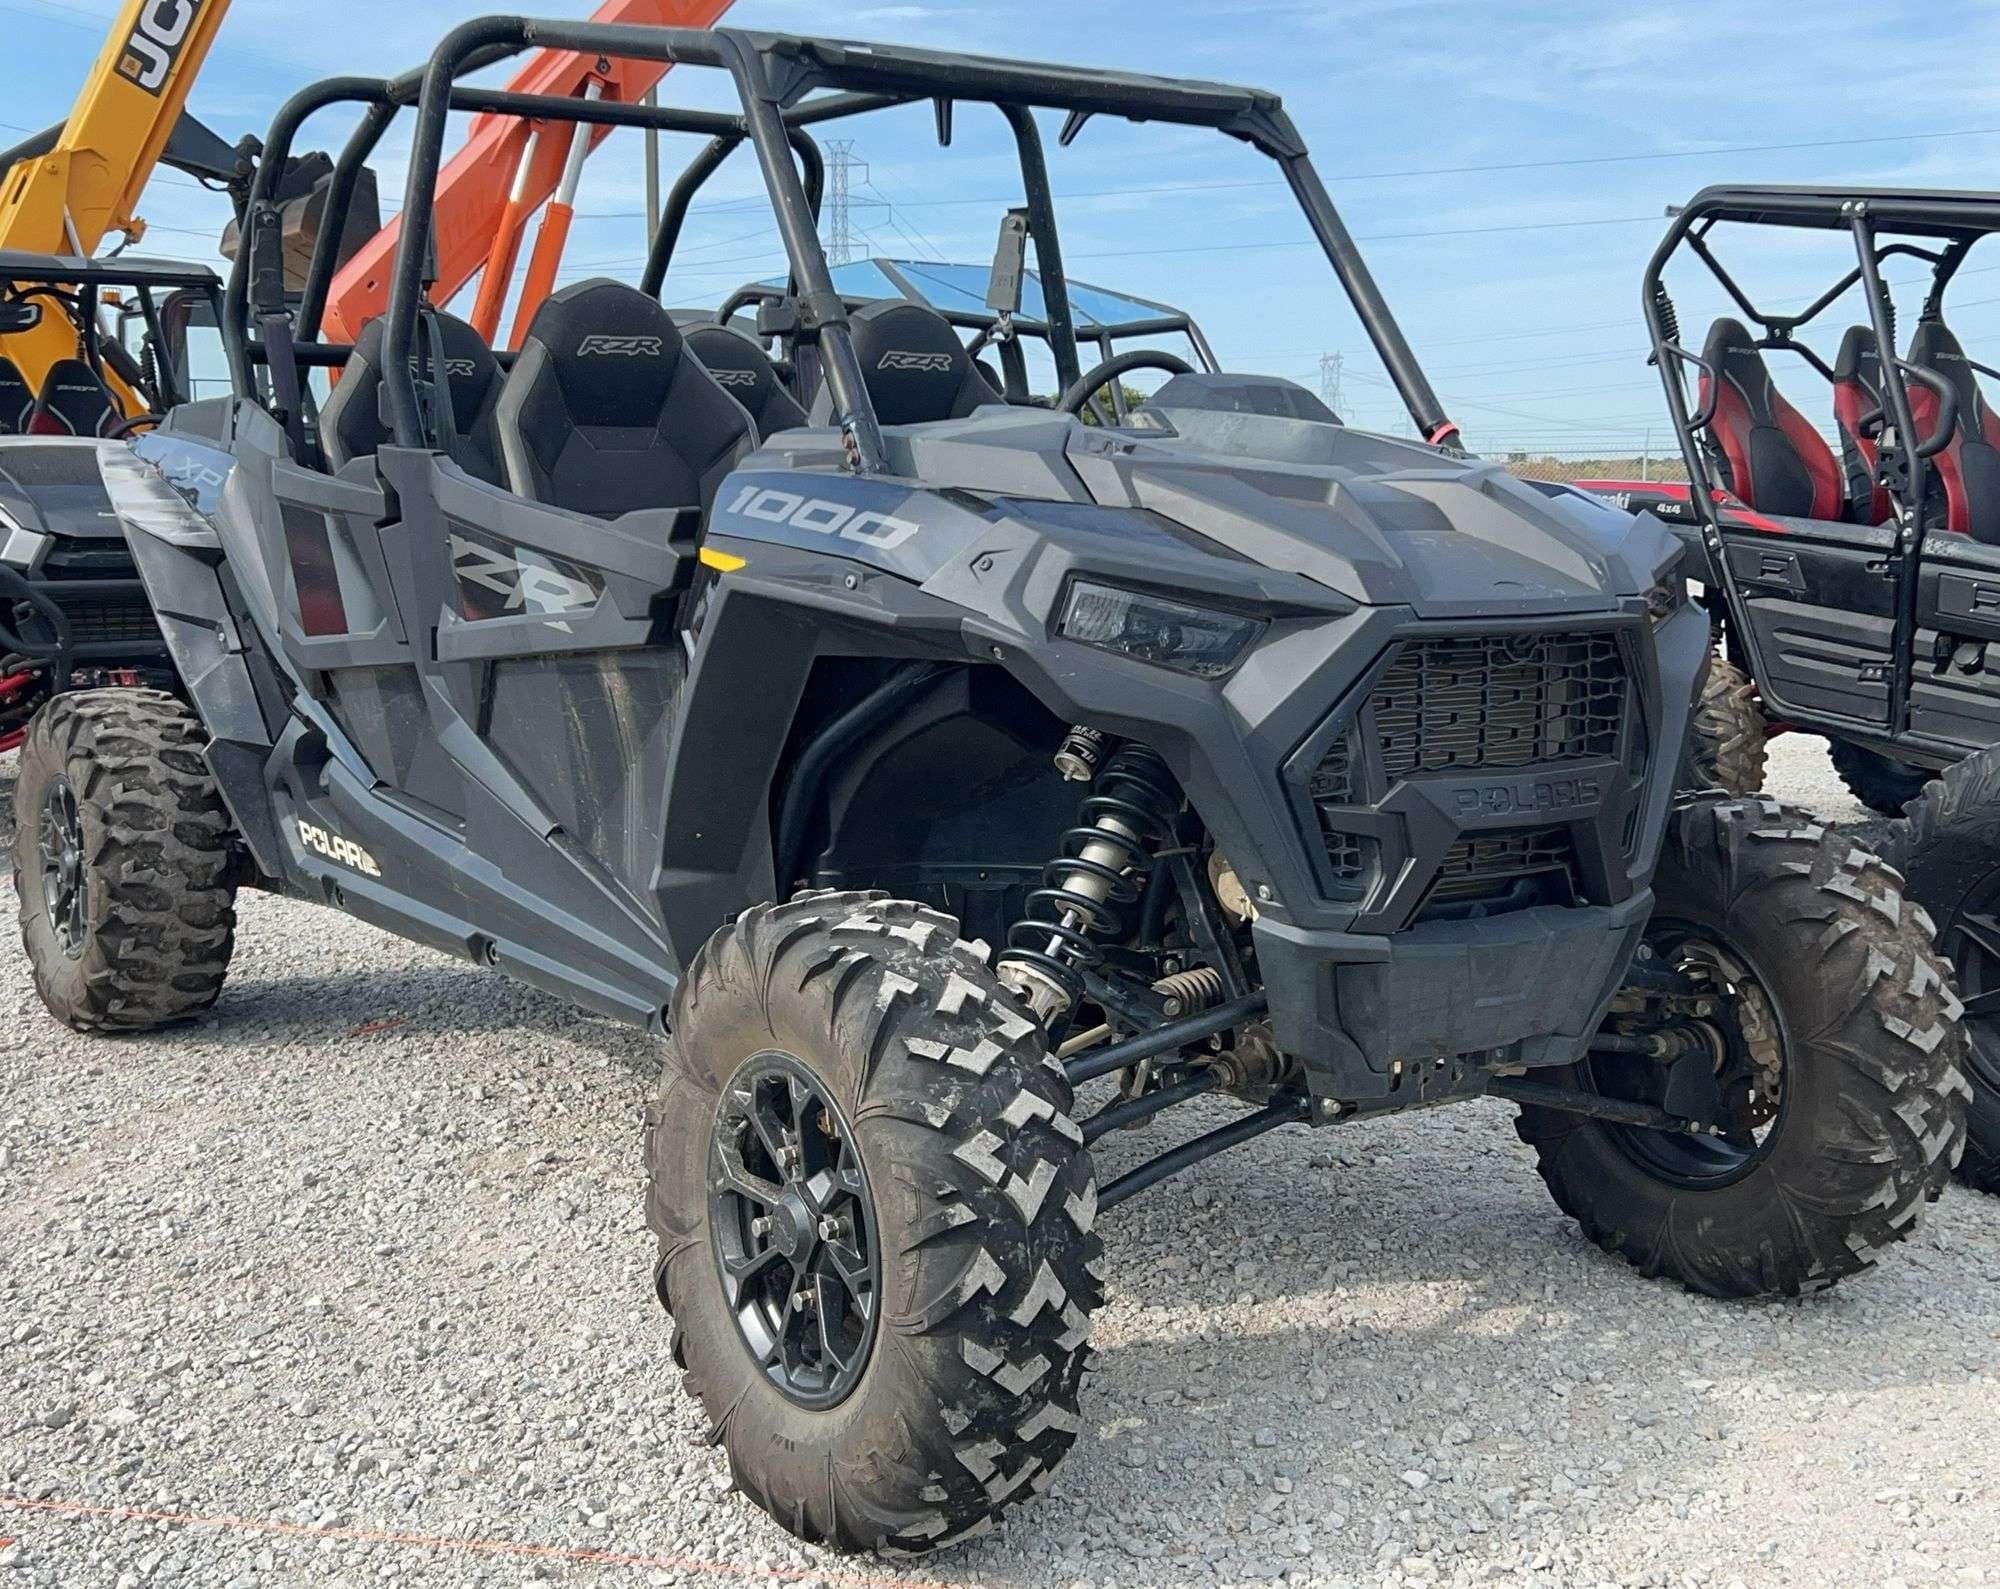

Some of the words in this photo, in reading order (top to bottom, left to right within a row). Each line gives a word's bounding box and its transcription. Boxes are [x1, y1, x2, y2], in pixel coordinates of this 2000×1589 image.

[128, 0, 192, 89] JC
[577, 335, 662, 356] RZR
[878, 350, 952, 371] RZR
[174, 455, 224, 487] XP
[727, 485, 920, 550] 1000
[1656, 503, 1681, 515] 4x4
[1451, 778, 1602, 818] POLARIS
